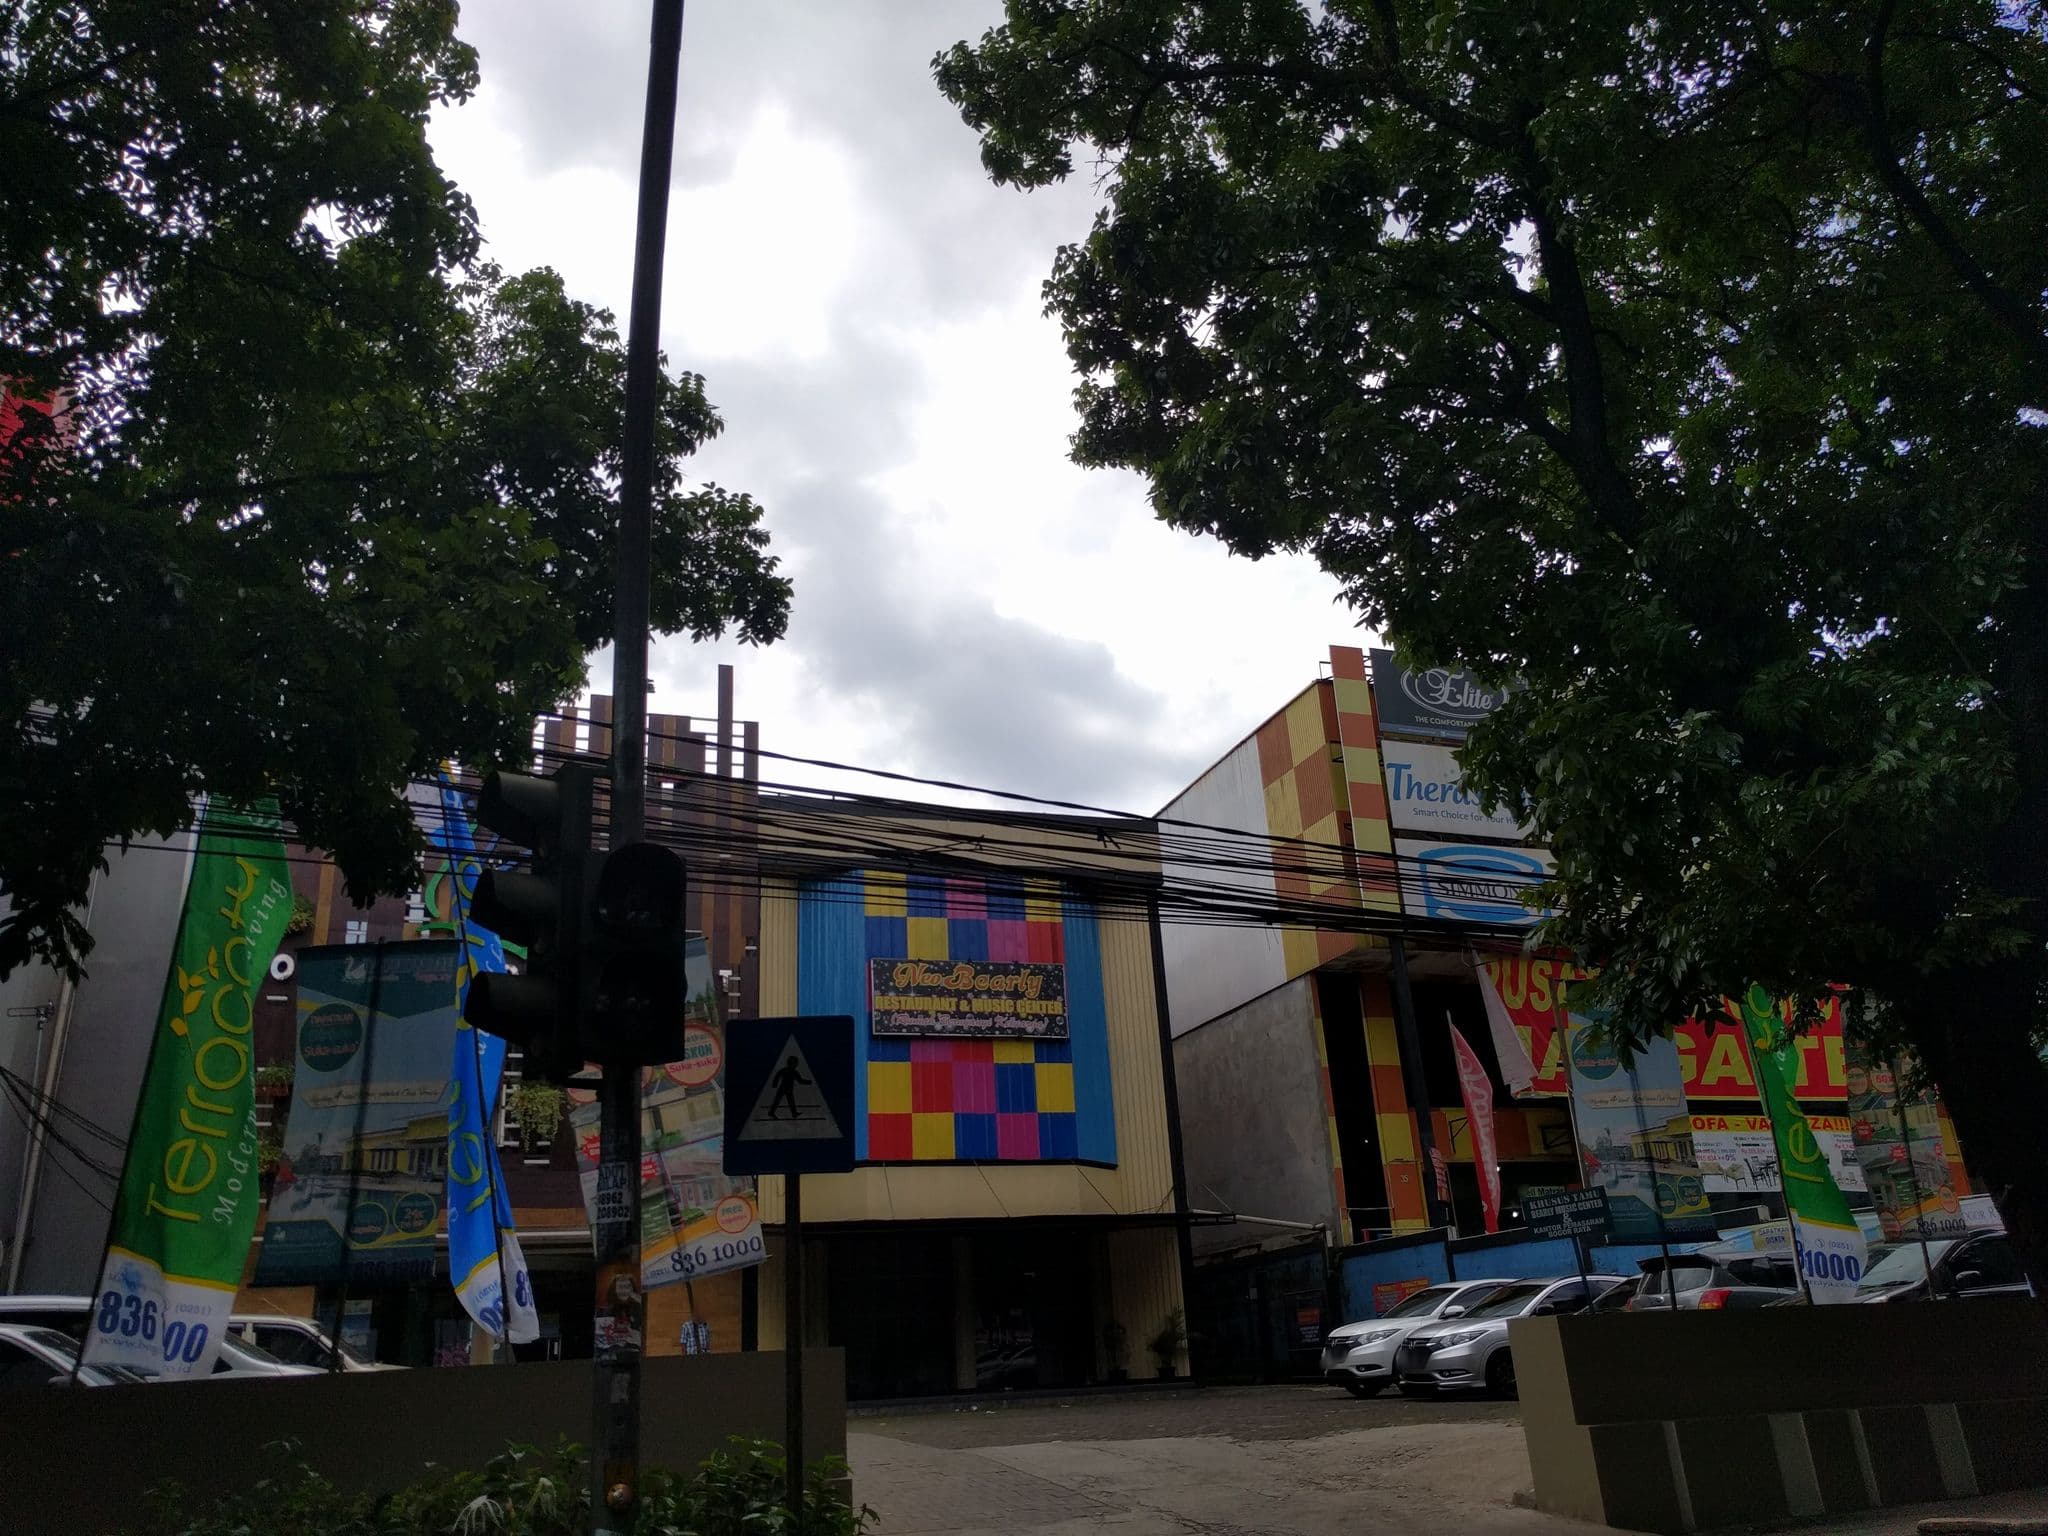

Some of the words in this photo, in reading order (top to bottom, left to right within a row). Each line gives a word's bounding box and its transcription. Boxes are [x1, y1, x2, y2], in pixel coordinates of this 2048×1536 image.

[1415, 668, 1493, 708] Elite
[1414, 715, 1429, 725] THE
[1412, 807, 1439, 818] Smart
[1440, 810, 1469, 821] Choice
[1471, 812, 1483, 822] for
[1438, 878, 1522, 901] SIMMON
[893, 962, 943, 988] Neo
[943, 964, 1043, 999] Bearly
[874, 995, 957, 1011] RESTAURANT
[959, 997, 971, 1011] &
[971, 997, 1014, 1014] MUSIC
[1016, 999, 1064, 1016] CENTER
[1692, 1119, 1729, 1131] OFA
[1529, 1198, 1570, 1210] KHUSUS
[1573, 1191, 1600, 1202] TAMU
[1555, 1202, 1577, 1215] MUSIC
[1578, 1199, 1604, 1210] CENTER
[1534, 1224, 1562, 1234] KANTOR
[1939, 1217, 1967, 1233] 1000
[671, 1244, 706, 1274] 836
[711, 1235, 762, 1262] 1000
[97, 1290, 158, 1341] 836
